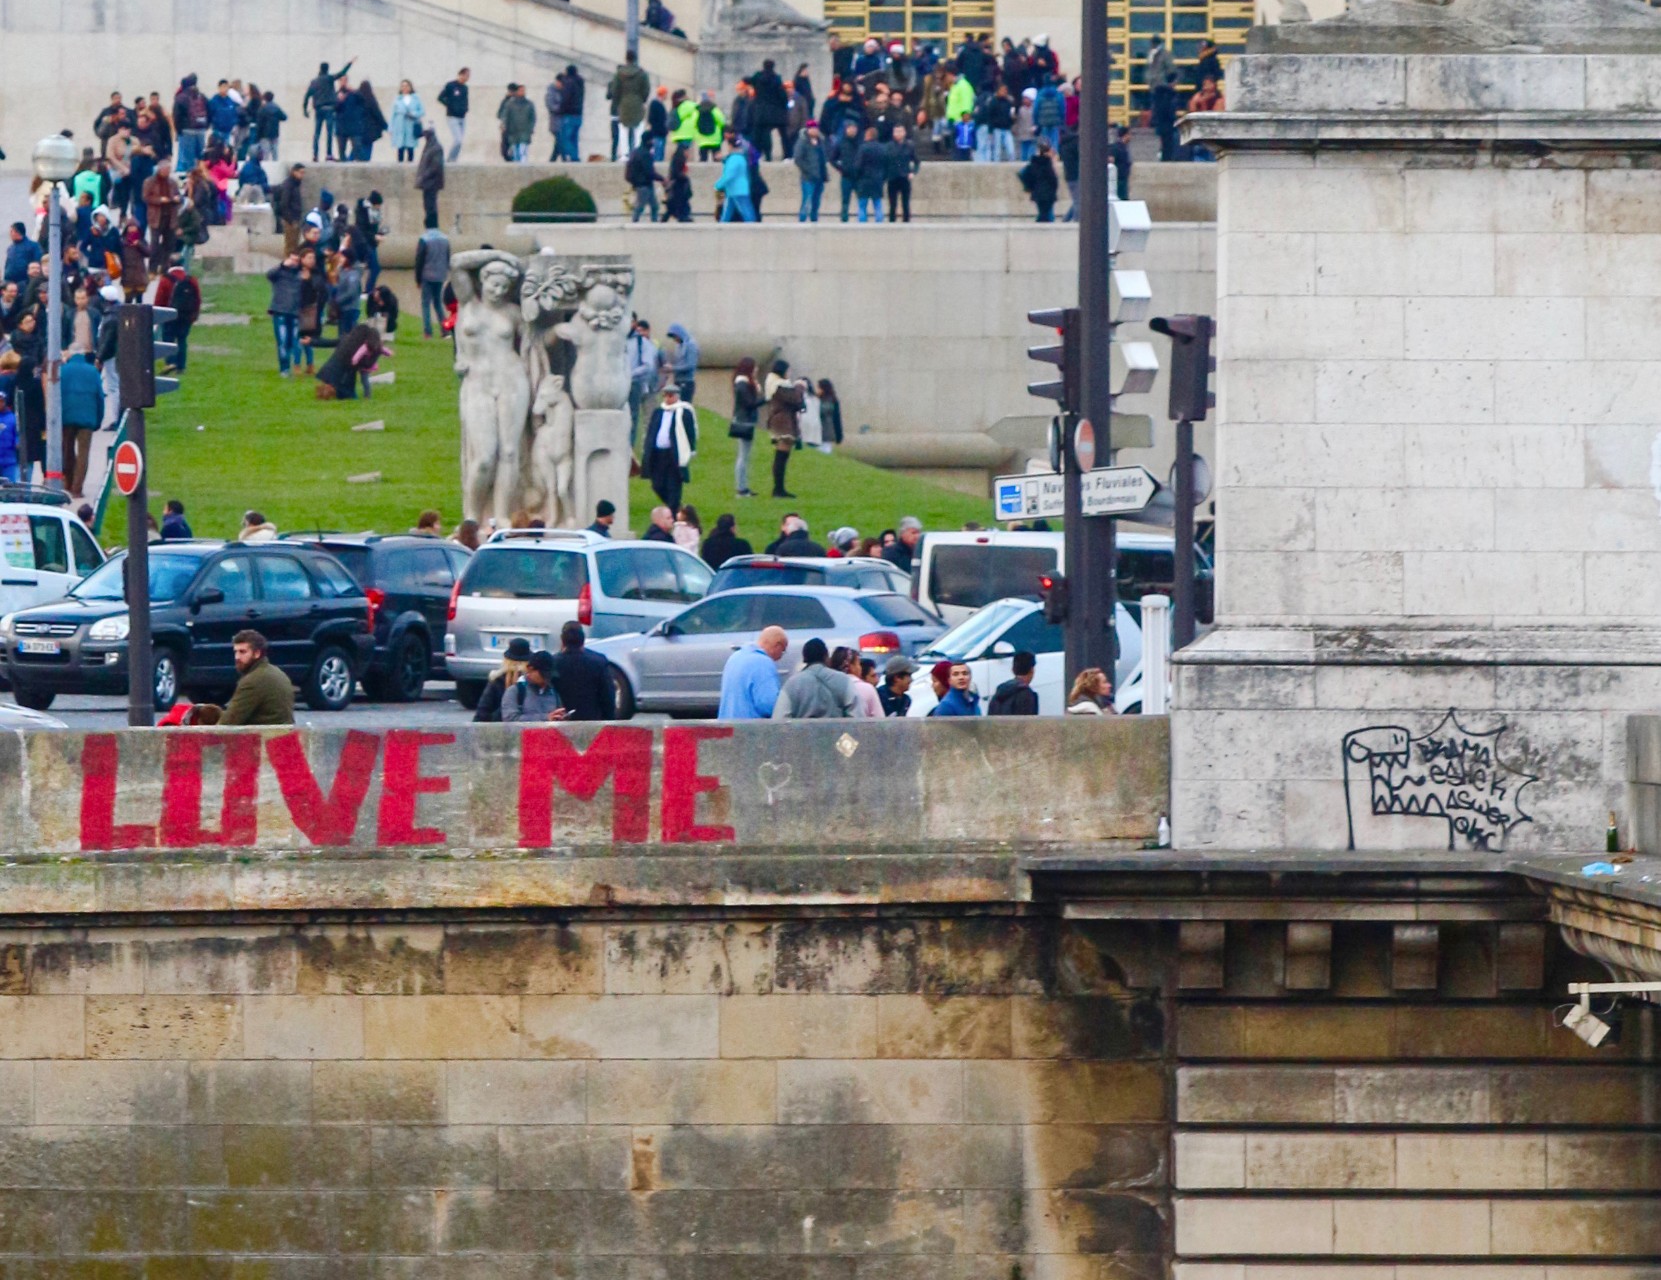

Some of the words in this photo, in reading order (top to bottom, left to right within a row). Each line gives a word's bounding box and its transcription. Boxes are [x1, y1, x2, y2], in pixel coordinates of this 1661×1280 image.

[1095, 475, 1144, 490] Fluviales
[80, 729, 456, 851] LOVE
[518, 725, 735, 849] ME
